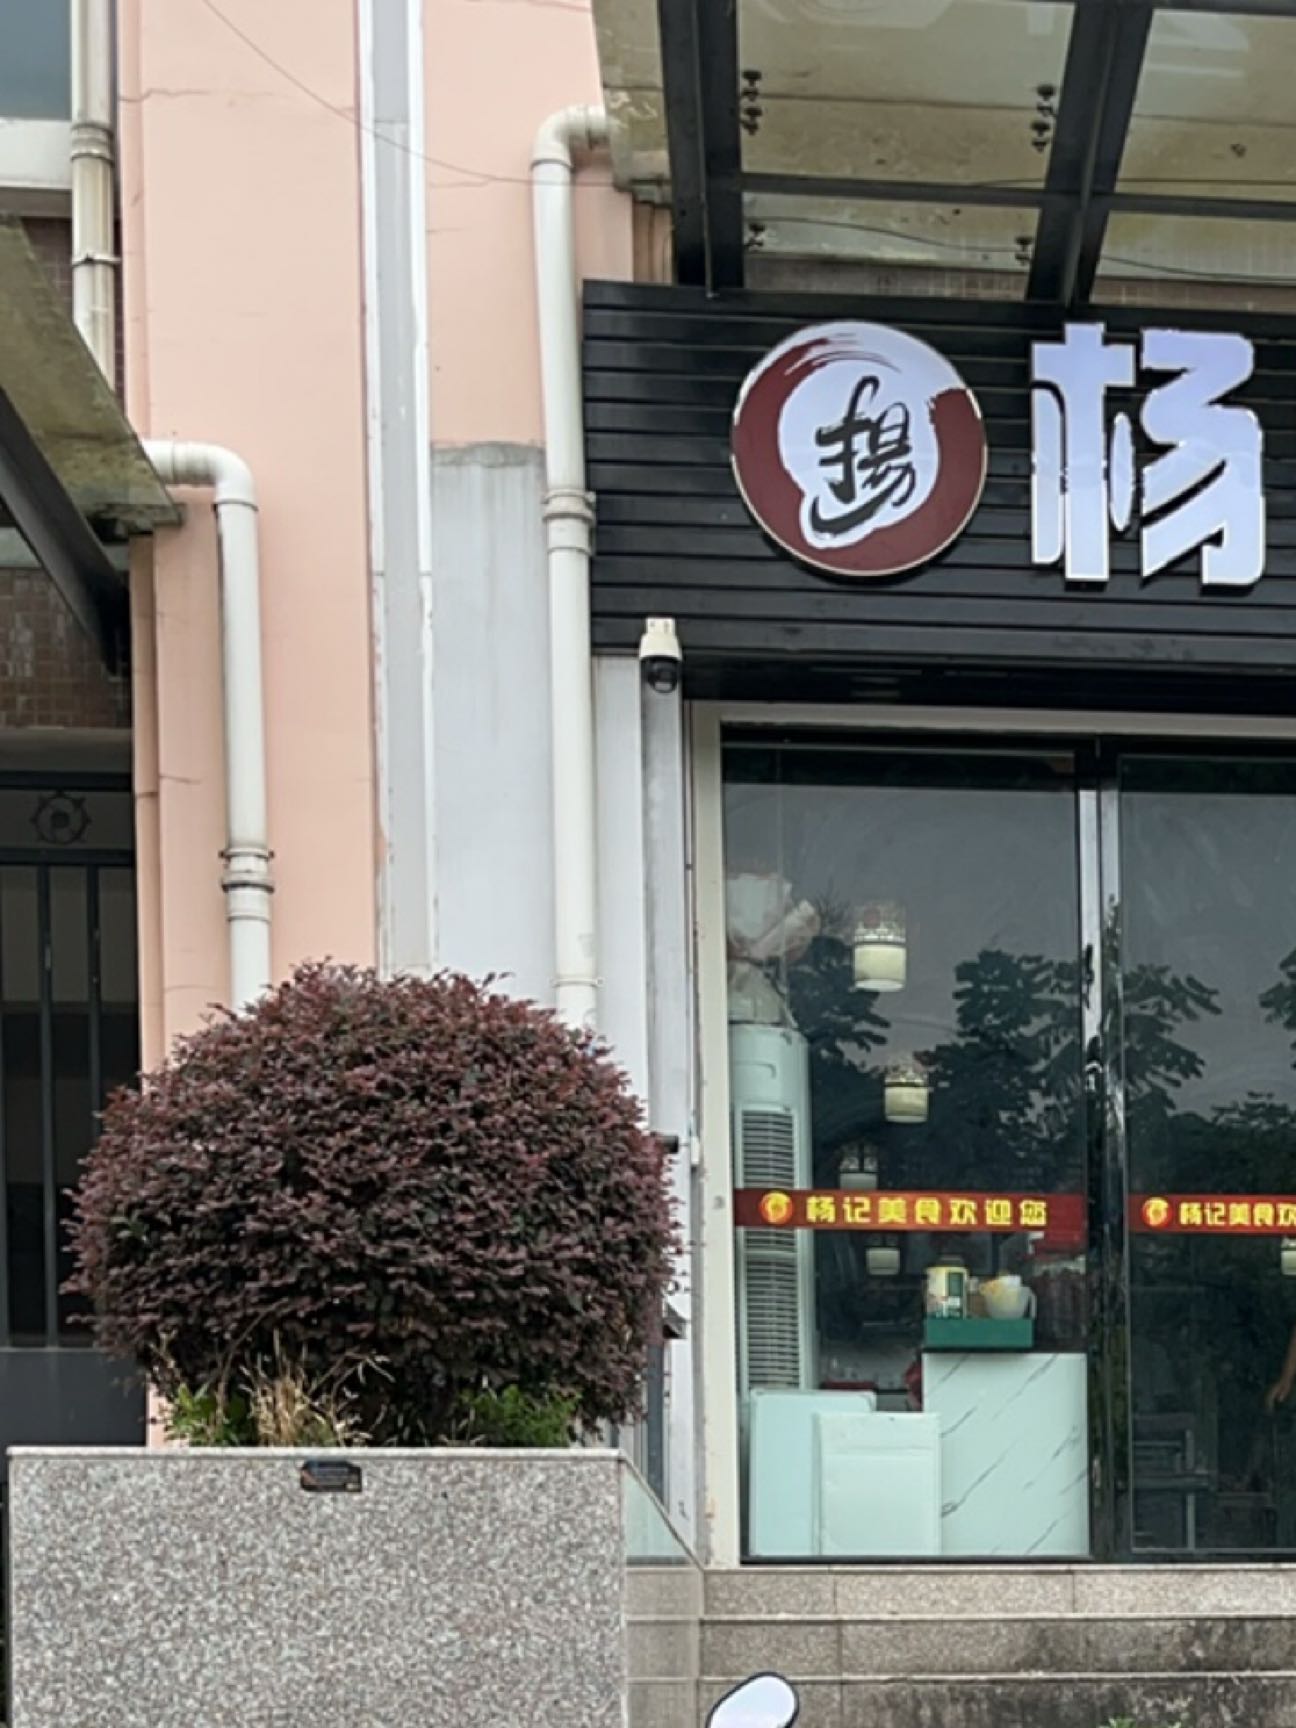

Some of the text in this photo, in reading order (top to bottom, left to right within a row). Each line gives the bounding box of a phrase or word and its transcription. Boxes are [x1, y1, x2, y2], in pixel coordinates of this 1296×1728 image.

[806, 1196, 1047, 1226] 杨记美食欢迎您
